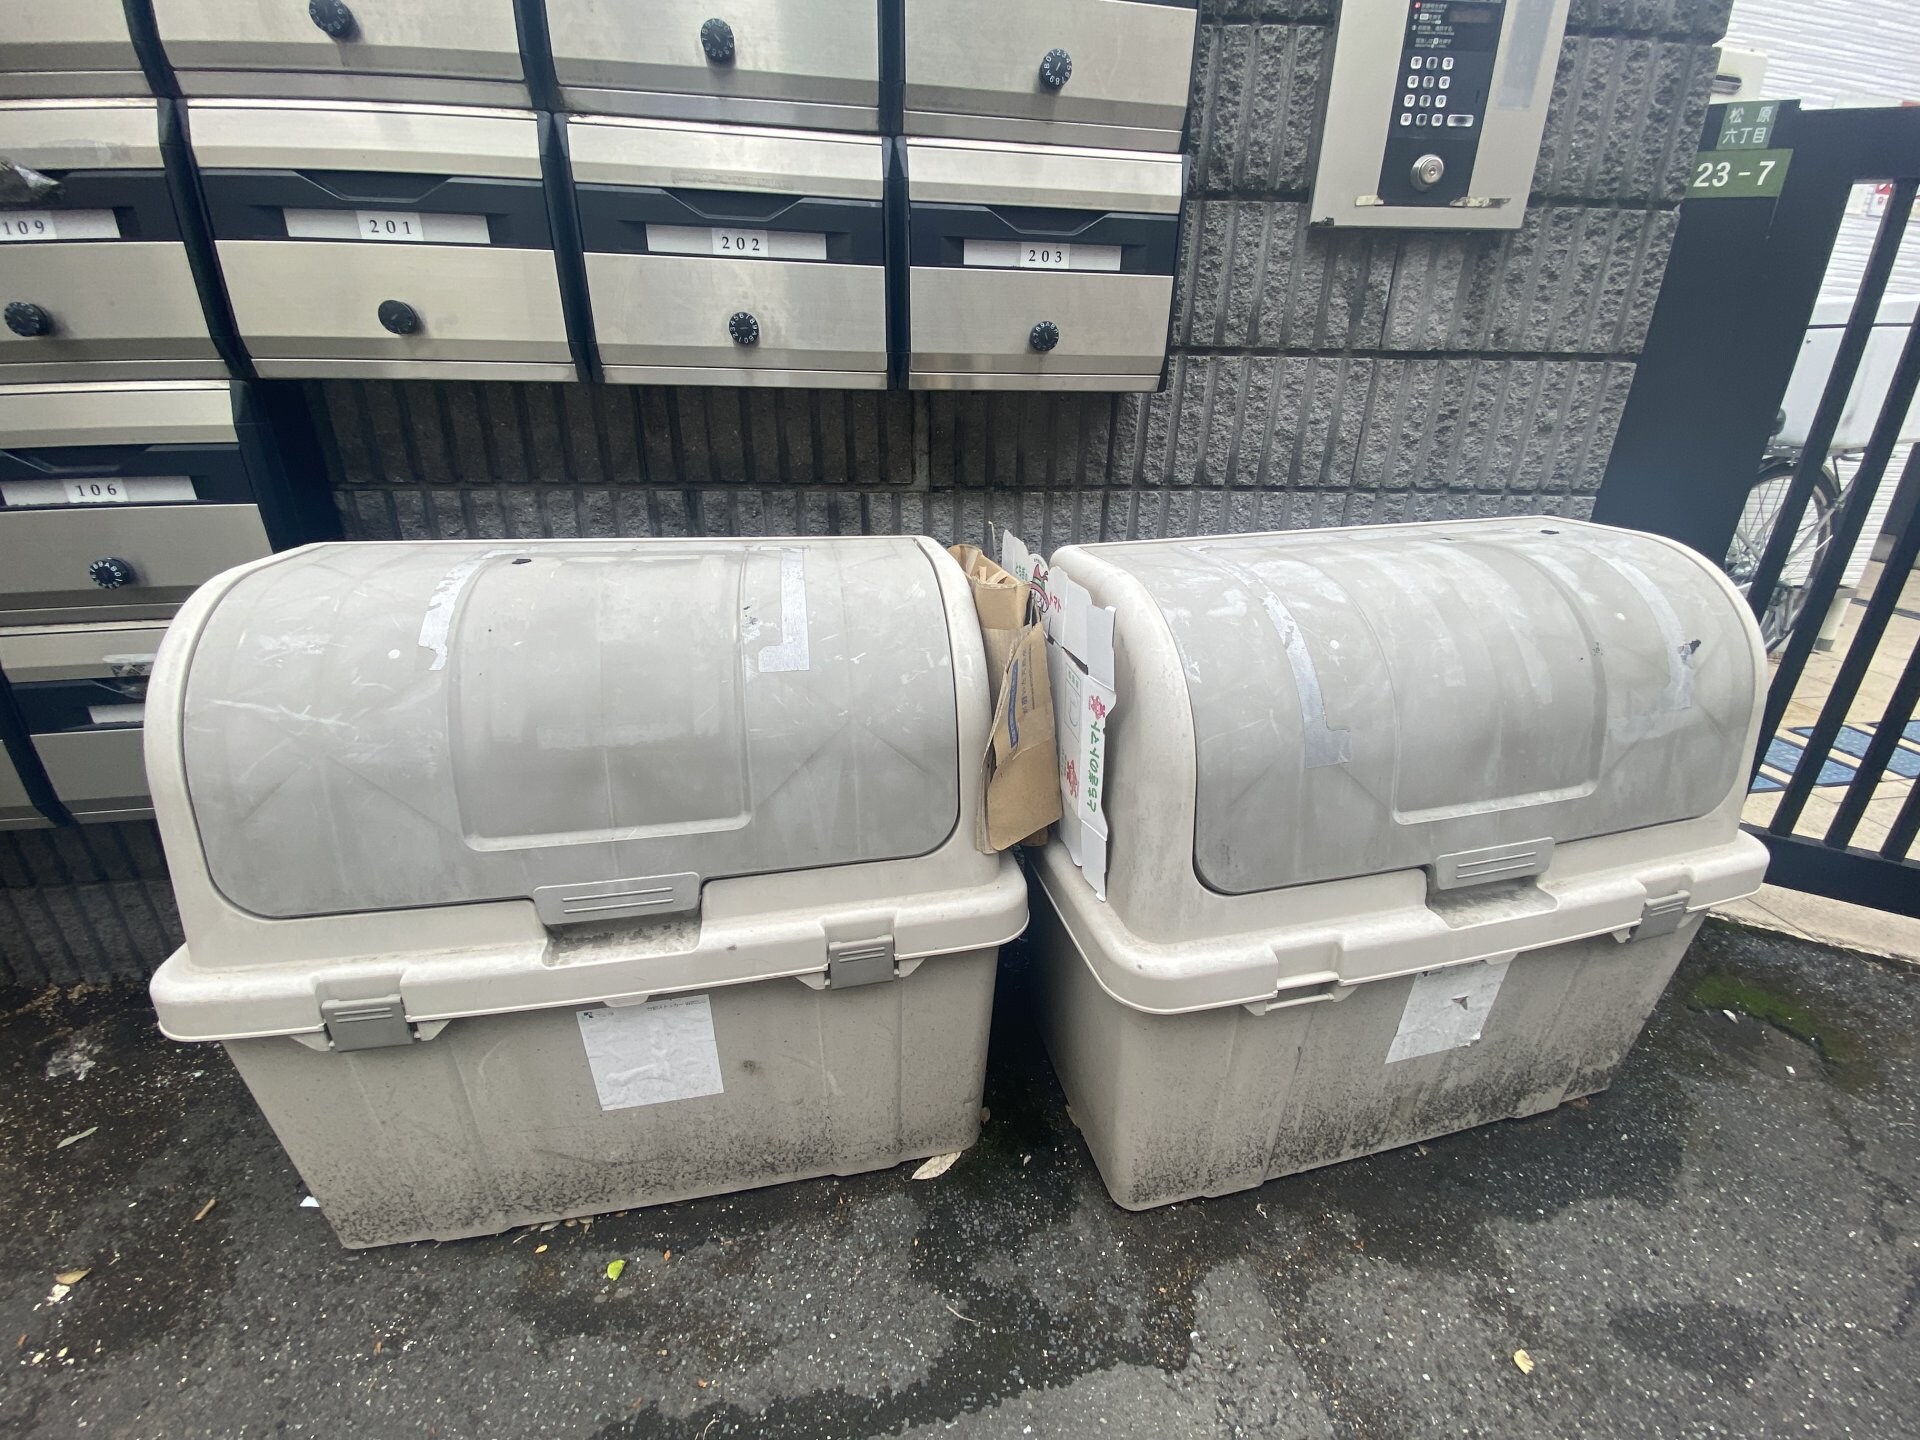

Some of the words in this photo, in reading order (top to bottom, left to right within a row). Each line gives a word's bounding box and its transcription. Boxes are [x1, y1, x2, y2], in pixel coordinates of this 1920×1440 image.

[1722, 127, 1767, 144] 六丁目
[2, 220, 45, 236] 109
[369, 219, 412, 235] 201
[721, 236, 760, 251] 202
[1029, 249, 1062, 263] 203
[75, 483, 117, 497] 106
[1086, 719, 1102, 813] とちぎのトマト
